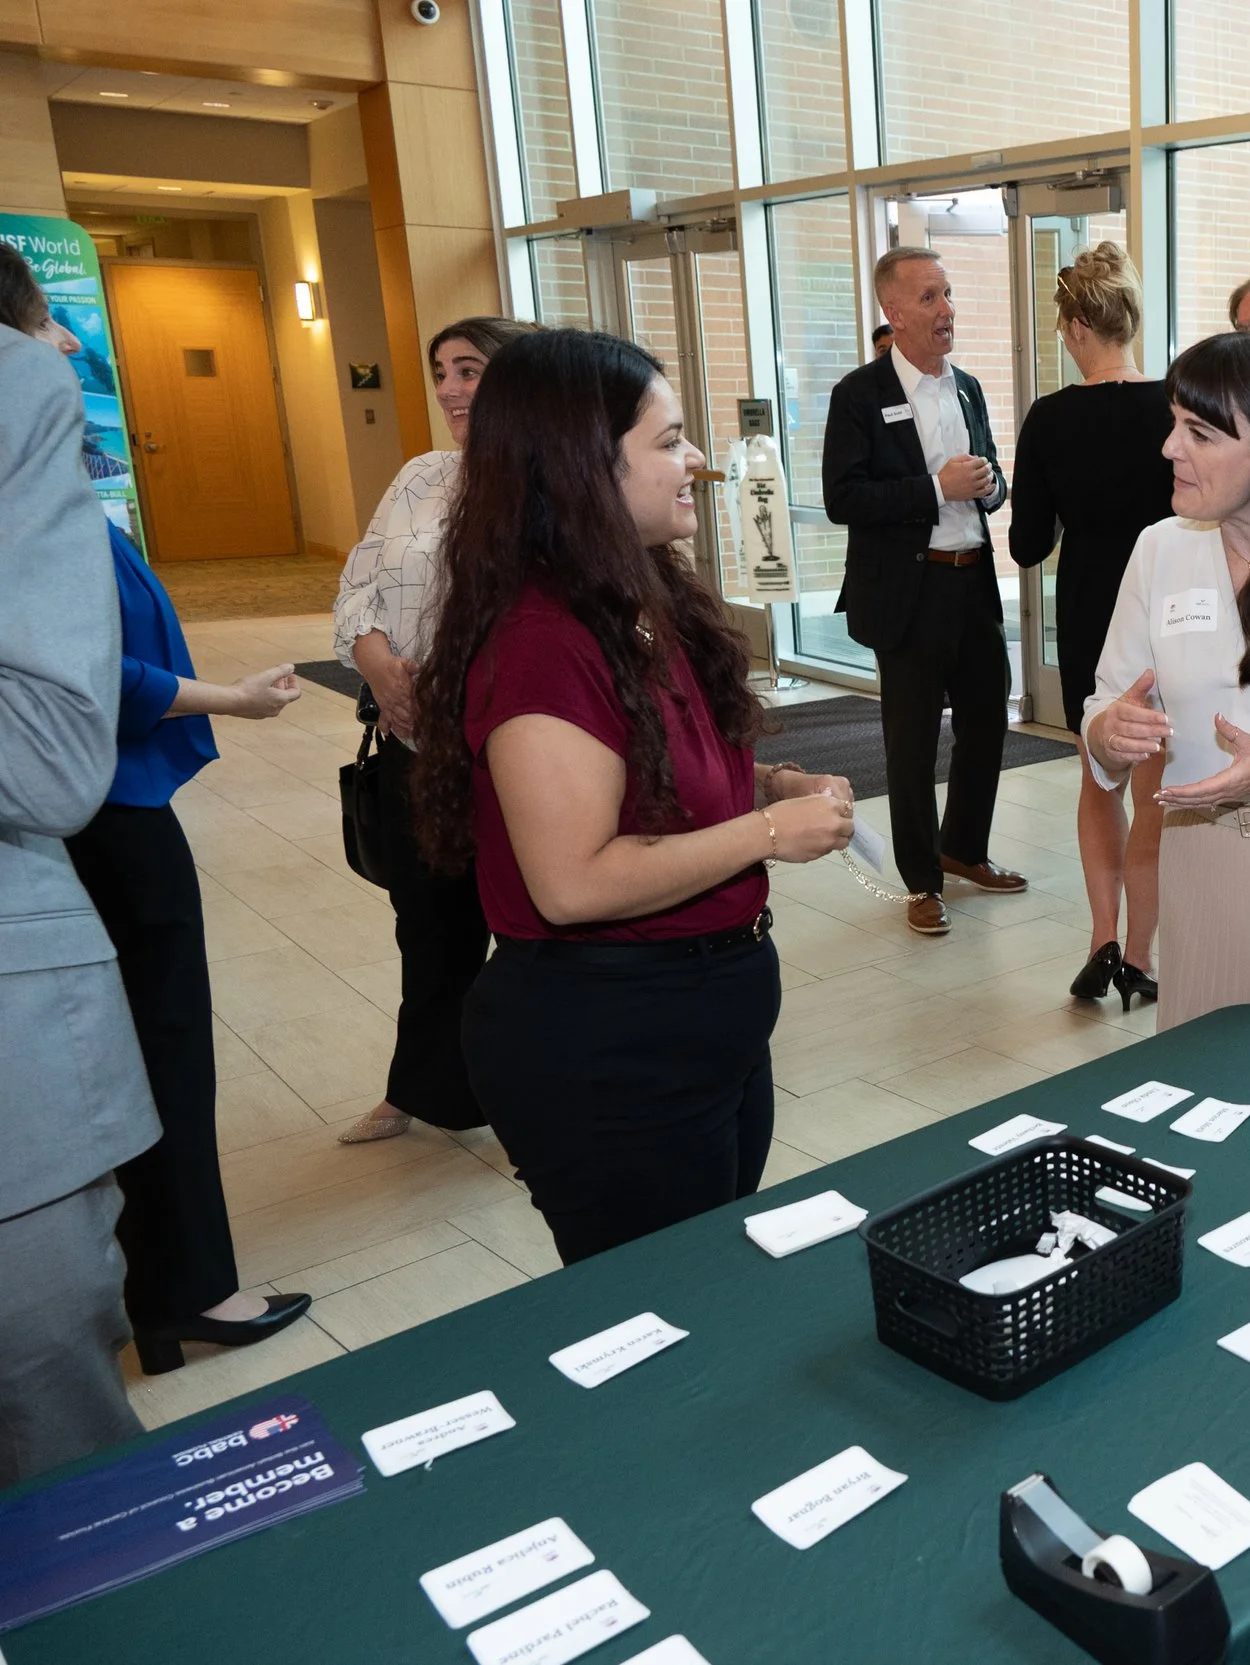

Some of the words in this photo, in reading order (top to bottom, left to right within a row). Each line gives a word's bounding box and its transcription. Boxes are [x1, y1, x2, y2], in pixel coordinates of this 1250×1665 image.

[0, 234, 27, 252] SF
[28, 236, 81, 256] World
[42, 258, 87, 280] Global.
[68, 295, 97, 304] PASSION
[627, 1328, 662, 1346] Karen
[574, 1346, 626, 1373] Krymski
[417, 1425, 466, 1446] Andrea
[175, 1433, 248, 1467] babc
[184, 1451, 325, 1510] member.
[204, 1463, 335, 1521] Become
[833, 1472, 872, 1496] Bryan
[140, 1493, 174, 1510] Council
[787, 1494, 833, 1523] Bognar
[93, 1511, 127, 1527] Central
[175, 1516, 198, 1531] a
[497, 1534, 558, 1566] Anjelica
[445, 1565, 494, 1591] Rubin
[566, 1599, 619, 1631] Rachel
